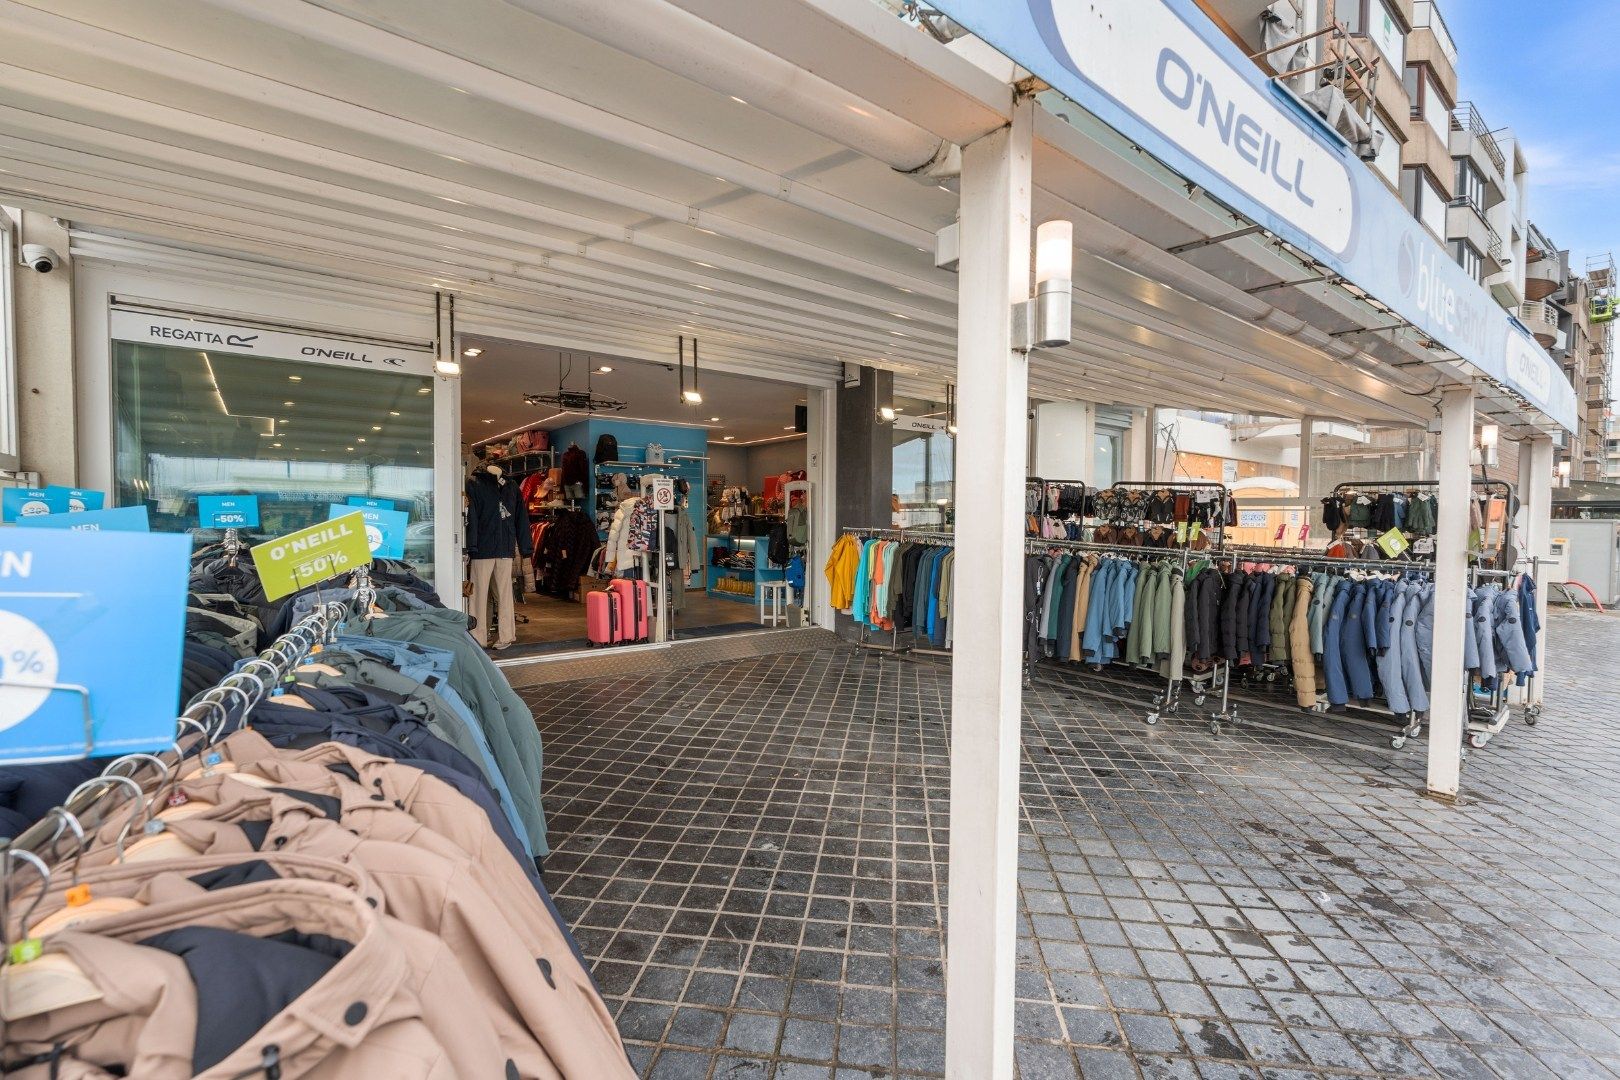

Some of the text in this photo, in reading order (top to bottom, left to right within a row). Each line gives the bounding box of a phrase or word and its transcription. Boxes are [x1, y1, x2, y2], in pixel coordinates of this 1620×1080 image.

[1156, 47, 1315, 208] O'NEILL
[150, 325, 223, 345] REGATTA
[300, 346, 373, 363] O'NEILL
[71, 523, 100, 532] MEN
[214, 514, 244, 523] -50%
[270, 523, 353, 561] O'NEILL
[0, 550, 33, 578] N
[290, 550, 348, 580] -50%
